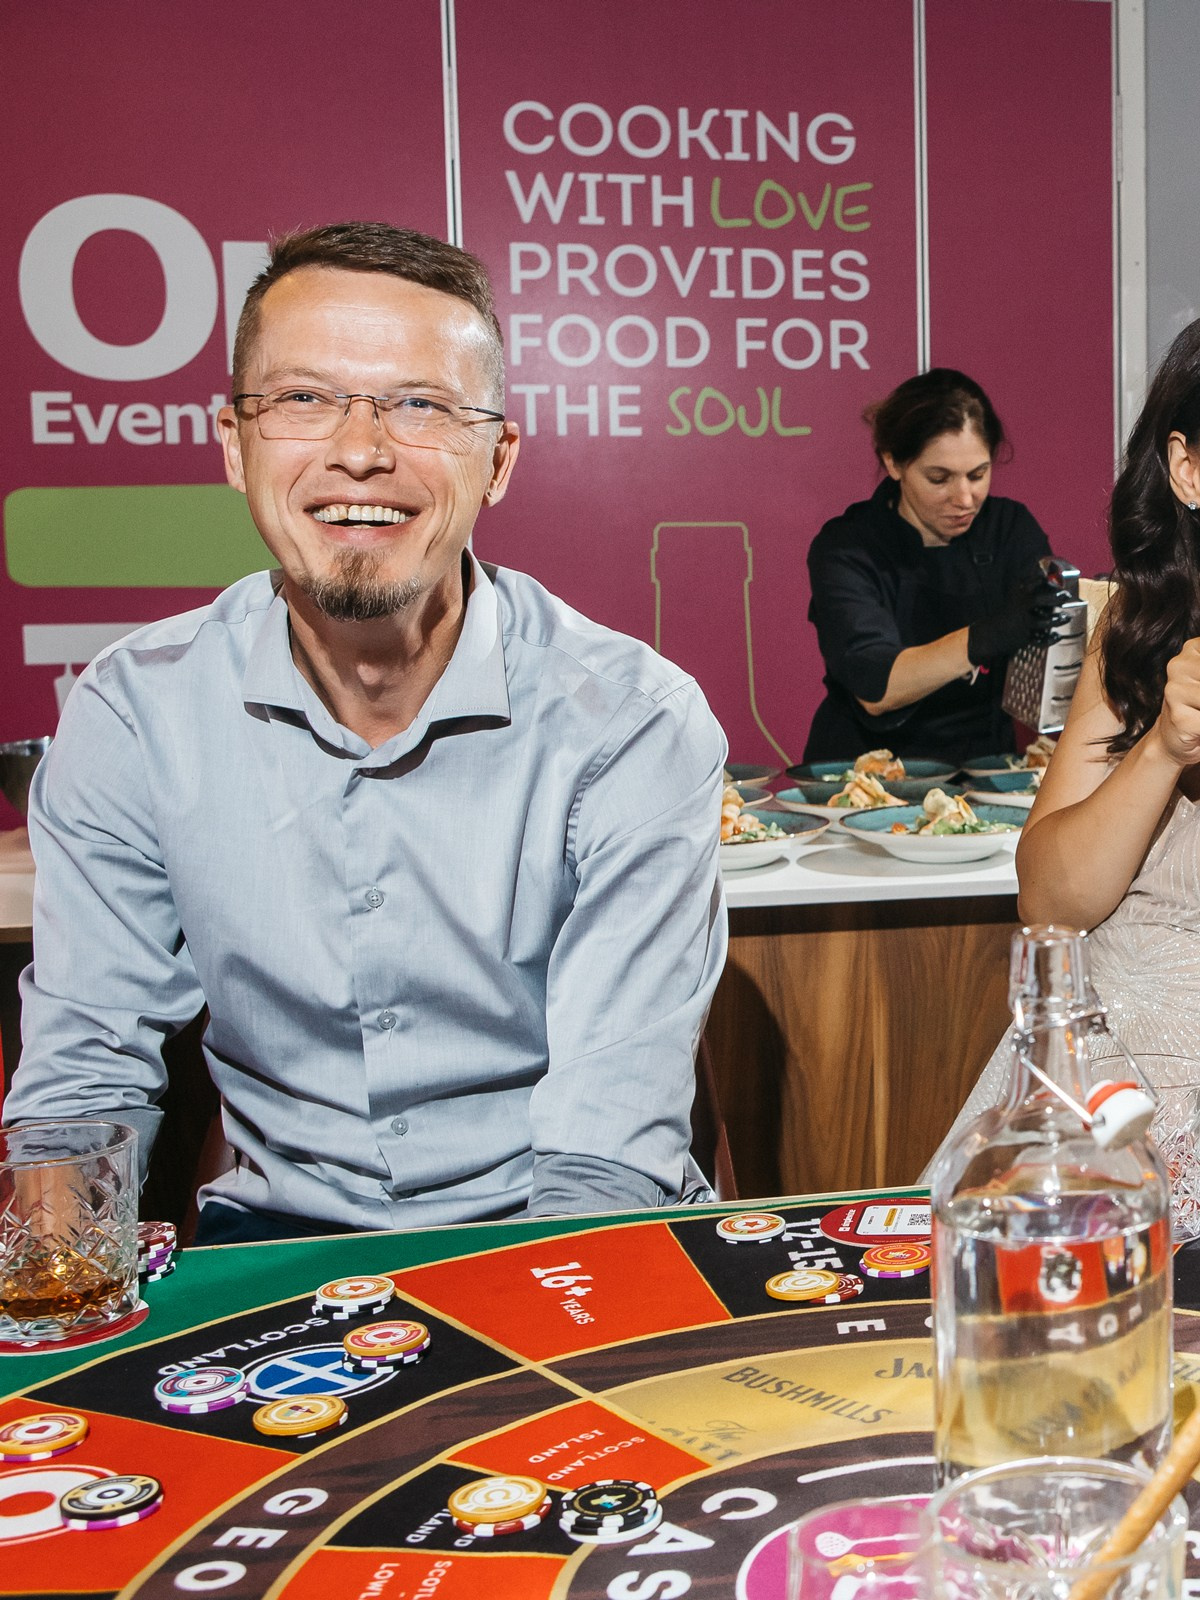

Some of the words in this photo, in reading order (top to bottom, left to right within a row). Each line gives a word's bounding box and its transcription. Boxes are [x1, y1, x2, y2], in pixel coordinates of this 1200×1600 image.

[503, 100, 857, 165] COOKING
[505, 169, 694, 228] WITH
[710, 176, 874, 233] LOVE
[508, 242, 871, 301] PROVIDES
[509, 313, 711, 369] FOOD
[735, 317, 871, 371] FOR
[510, 383, 643, 438] THE
[665, 386, 813, 438] SOUL
[530, 1261, 594, 1296] 16+
[560, 1298, 596, 1325] YEARS
[158, 1316, 330, 1376] SCOTLAND
[721, 1365, 895, 1425] BUSHMILLS
[528, 1429, 606, 1464] ISLAND
[547, 1436, 646, 1482] SCOTLAND
